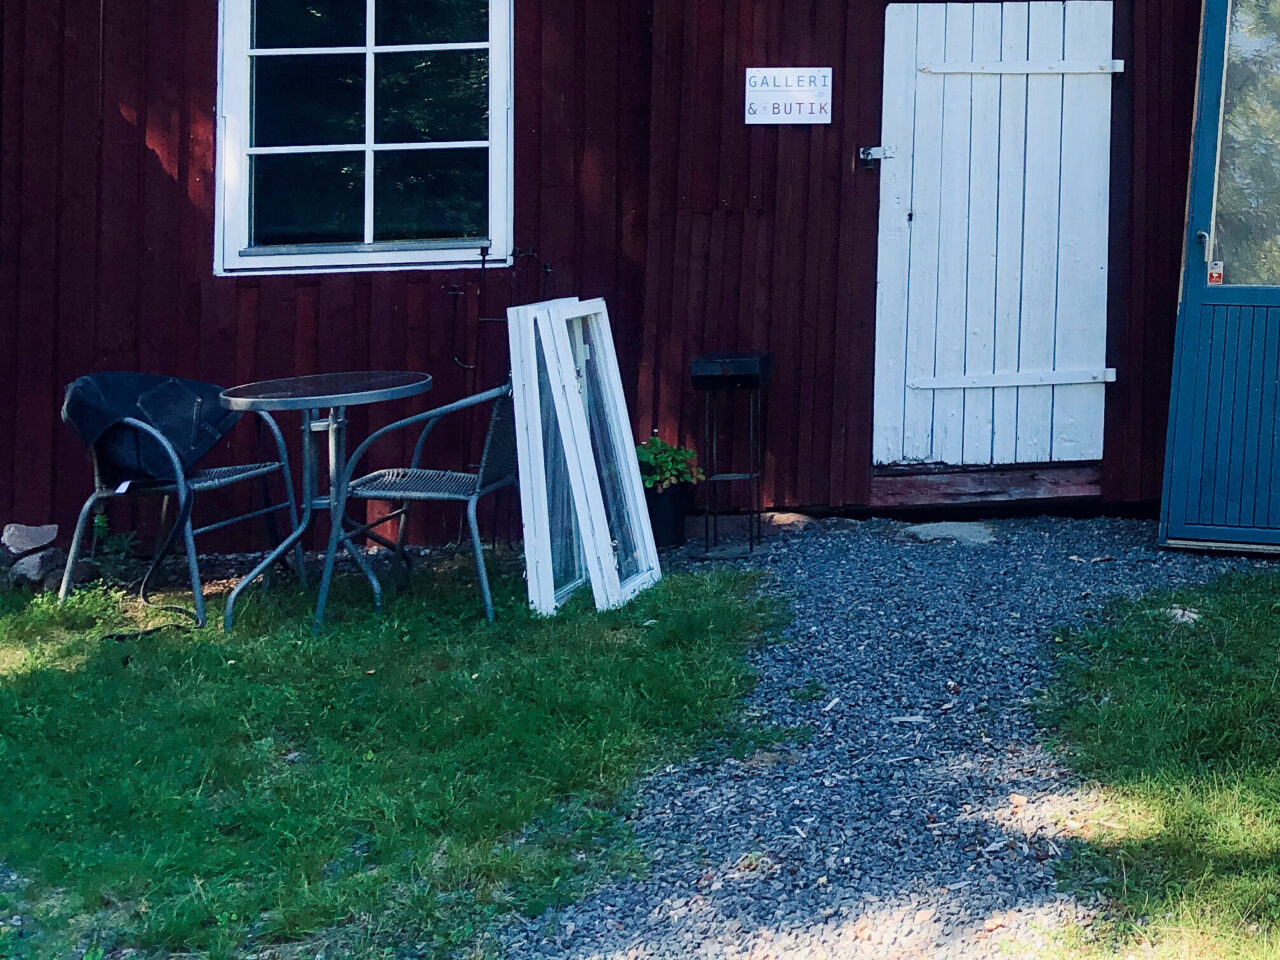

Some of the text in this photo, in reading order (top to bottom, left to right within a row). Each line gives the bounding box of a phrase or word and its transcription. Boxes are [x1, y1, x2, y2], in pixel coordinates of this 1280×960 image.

[748, 75, 829, 88] GALLERI
[747, 102, 829, 115] & BUTIK
